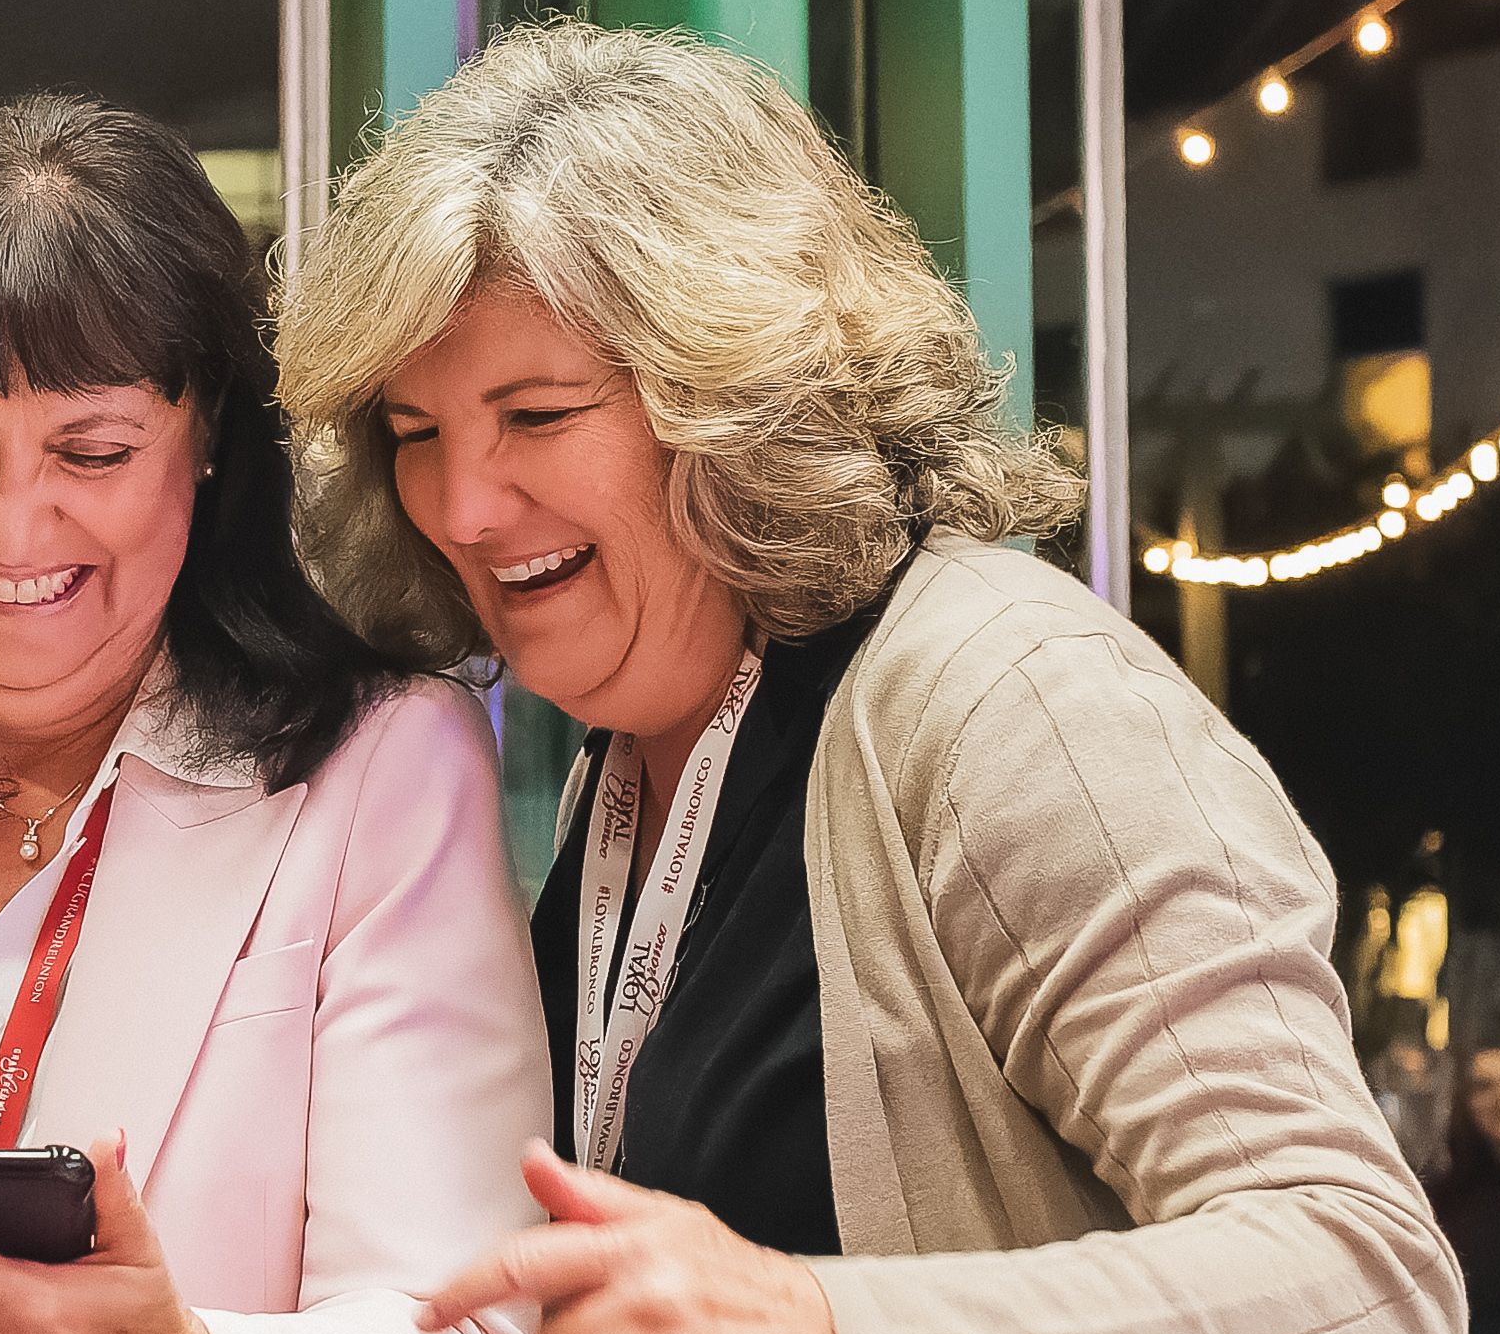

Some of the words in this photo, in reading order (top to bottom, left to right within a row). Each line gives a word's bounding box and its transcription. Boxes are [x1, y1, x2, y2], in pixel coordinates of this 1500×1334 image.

[612, 778, 638, 843] LOYAL
[660, 756, 712, 895] #LOYALBRONCO
[587, 884, 612, 1015] #LOYALBRONCO
[618, 940, 651, 1014] LOYAL
[593, 1038, 634, 1165] LOYALBRONCO
